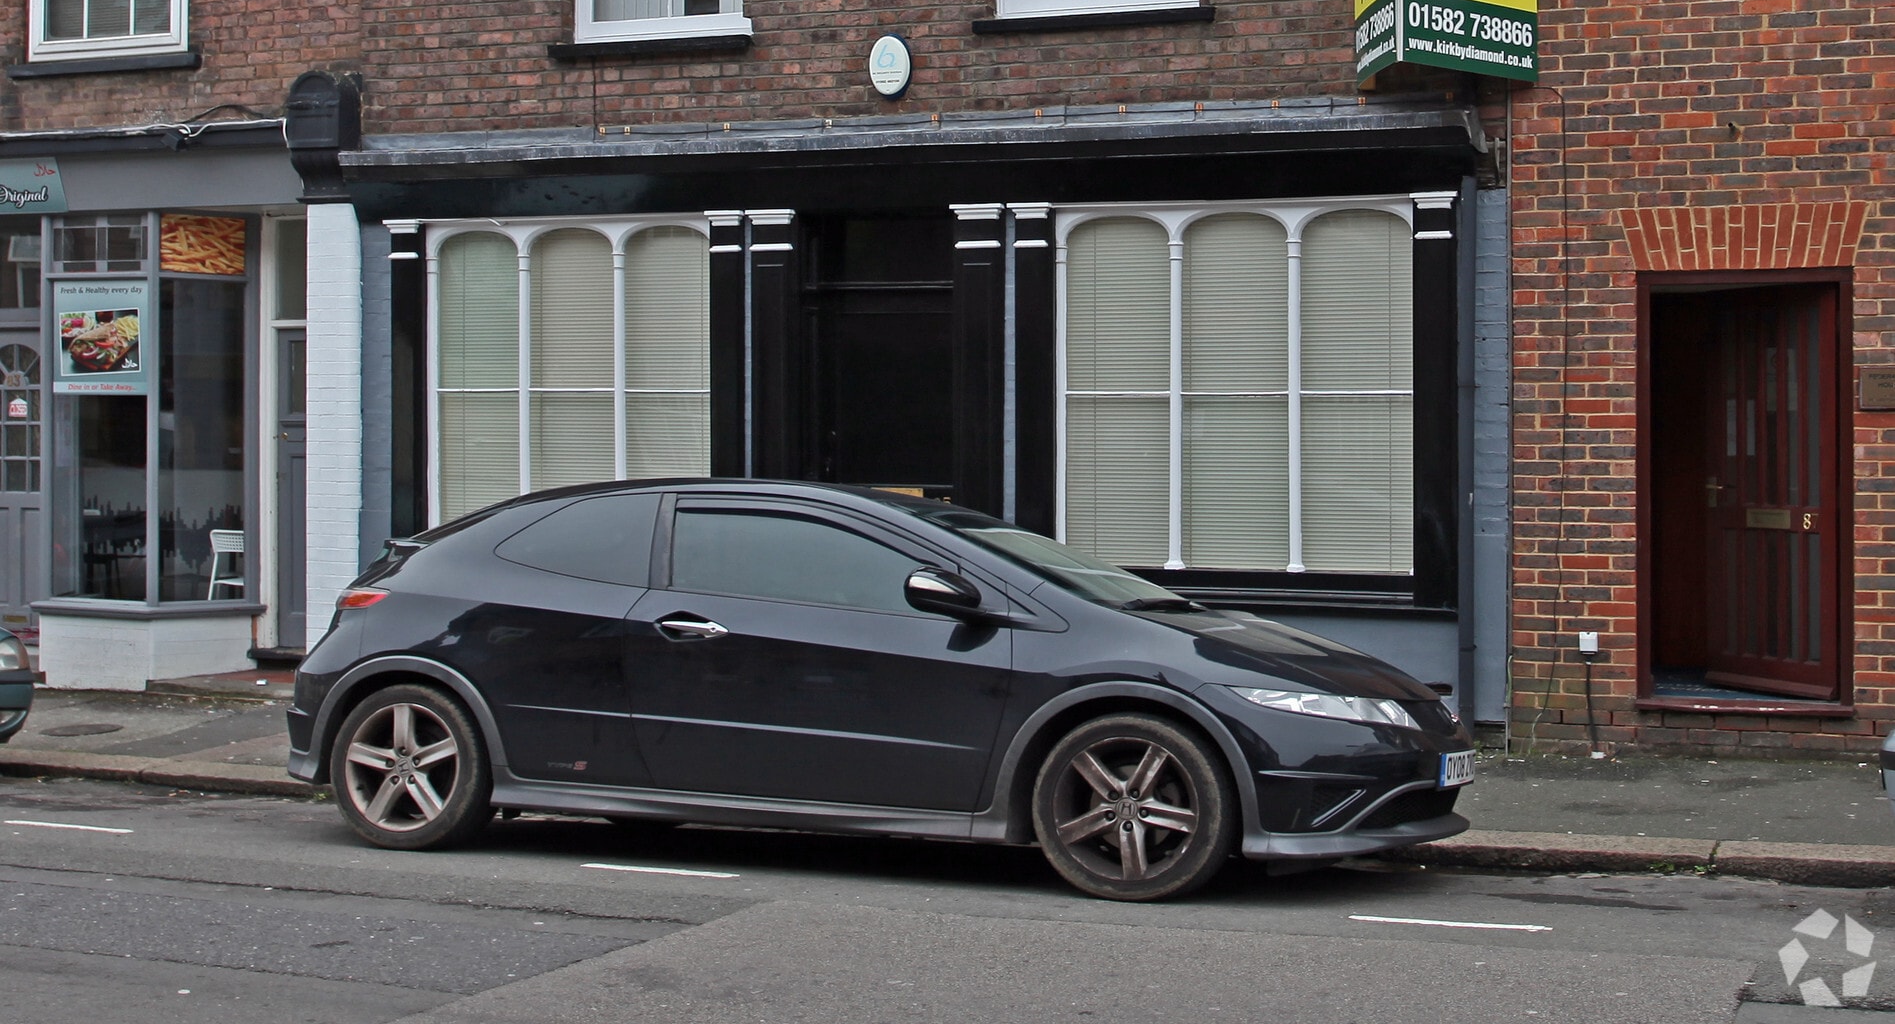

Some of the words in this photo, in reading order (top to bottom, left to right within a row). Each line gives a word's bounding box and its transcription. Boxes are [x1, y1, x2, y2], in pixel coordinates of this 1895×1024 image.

[1408, 2, 1465, 35] 01582
[1469, 13, 1533, 47] 738866
[1408, 37, 1533, 69] www.kirkbydiamond.co.uk
[60, 286, 77, 294] Fresh
[85, 286, 110, 295] Healthy
[111, 287, 129, 295] every
[130, 286, 143, 295] day
[68, 383, 82, 391] Dine
[100, 383, 113, 391] Take
